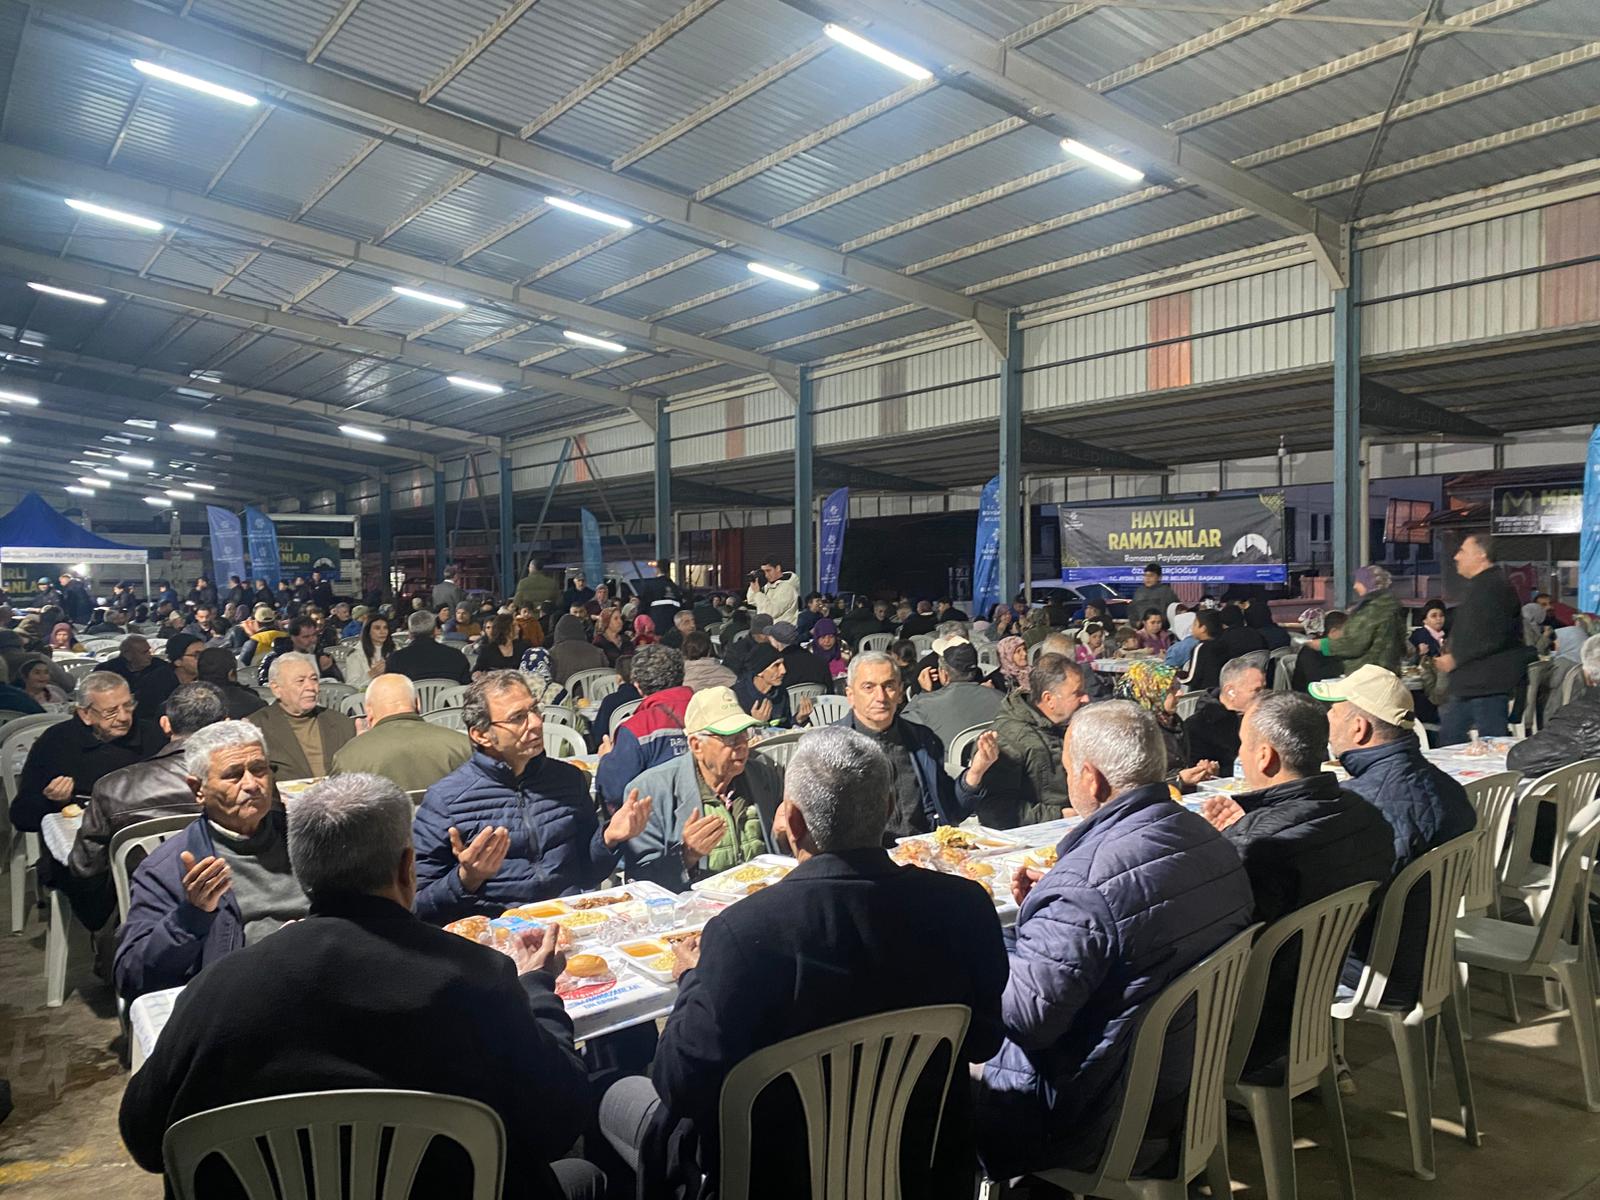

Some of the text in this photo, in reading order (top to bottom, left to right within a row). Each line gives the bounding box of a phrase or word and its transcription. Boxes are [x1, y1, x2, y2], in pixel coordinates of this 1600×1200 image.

[1131, 508, 1194, 529] HAYIRLI
[1108, 529, 1222, 550] RAMAZANLAR
[1124, 554, 1157, 562] Ramazan
[1161, 566, 1199, 575] ERÇİOĞLU
